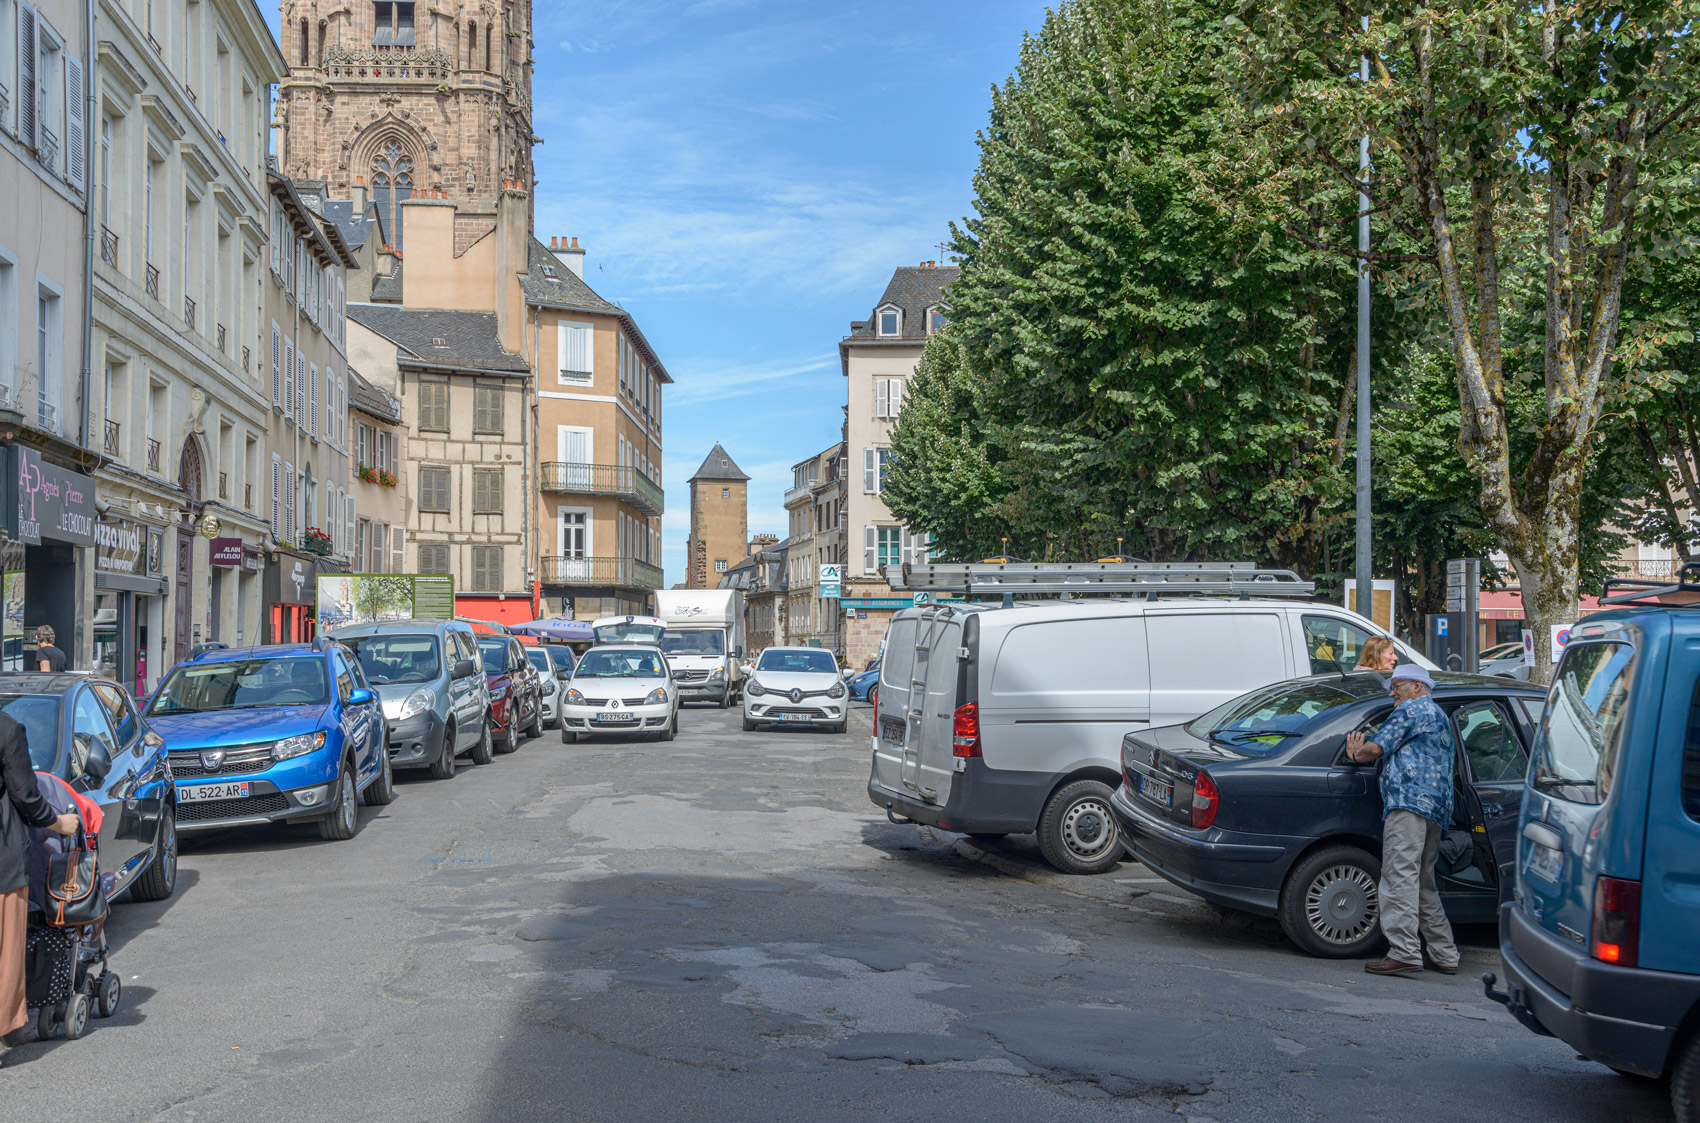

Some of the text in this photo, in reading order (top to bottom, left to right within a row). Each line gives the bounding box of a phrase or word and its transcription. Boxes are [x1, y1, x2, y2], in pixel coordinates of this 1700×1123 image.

[41, 473, 60, 502] Agnès
[65, 480, 83, 507] Pierre
[19, 503, 24, 519] LE
[19, 519, 40, 539] CHOCOLAT
[62, 512, 92, 536] LE CHOCOLAT
[1506, 611, 1520, 619] LE
